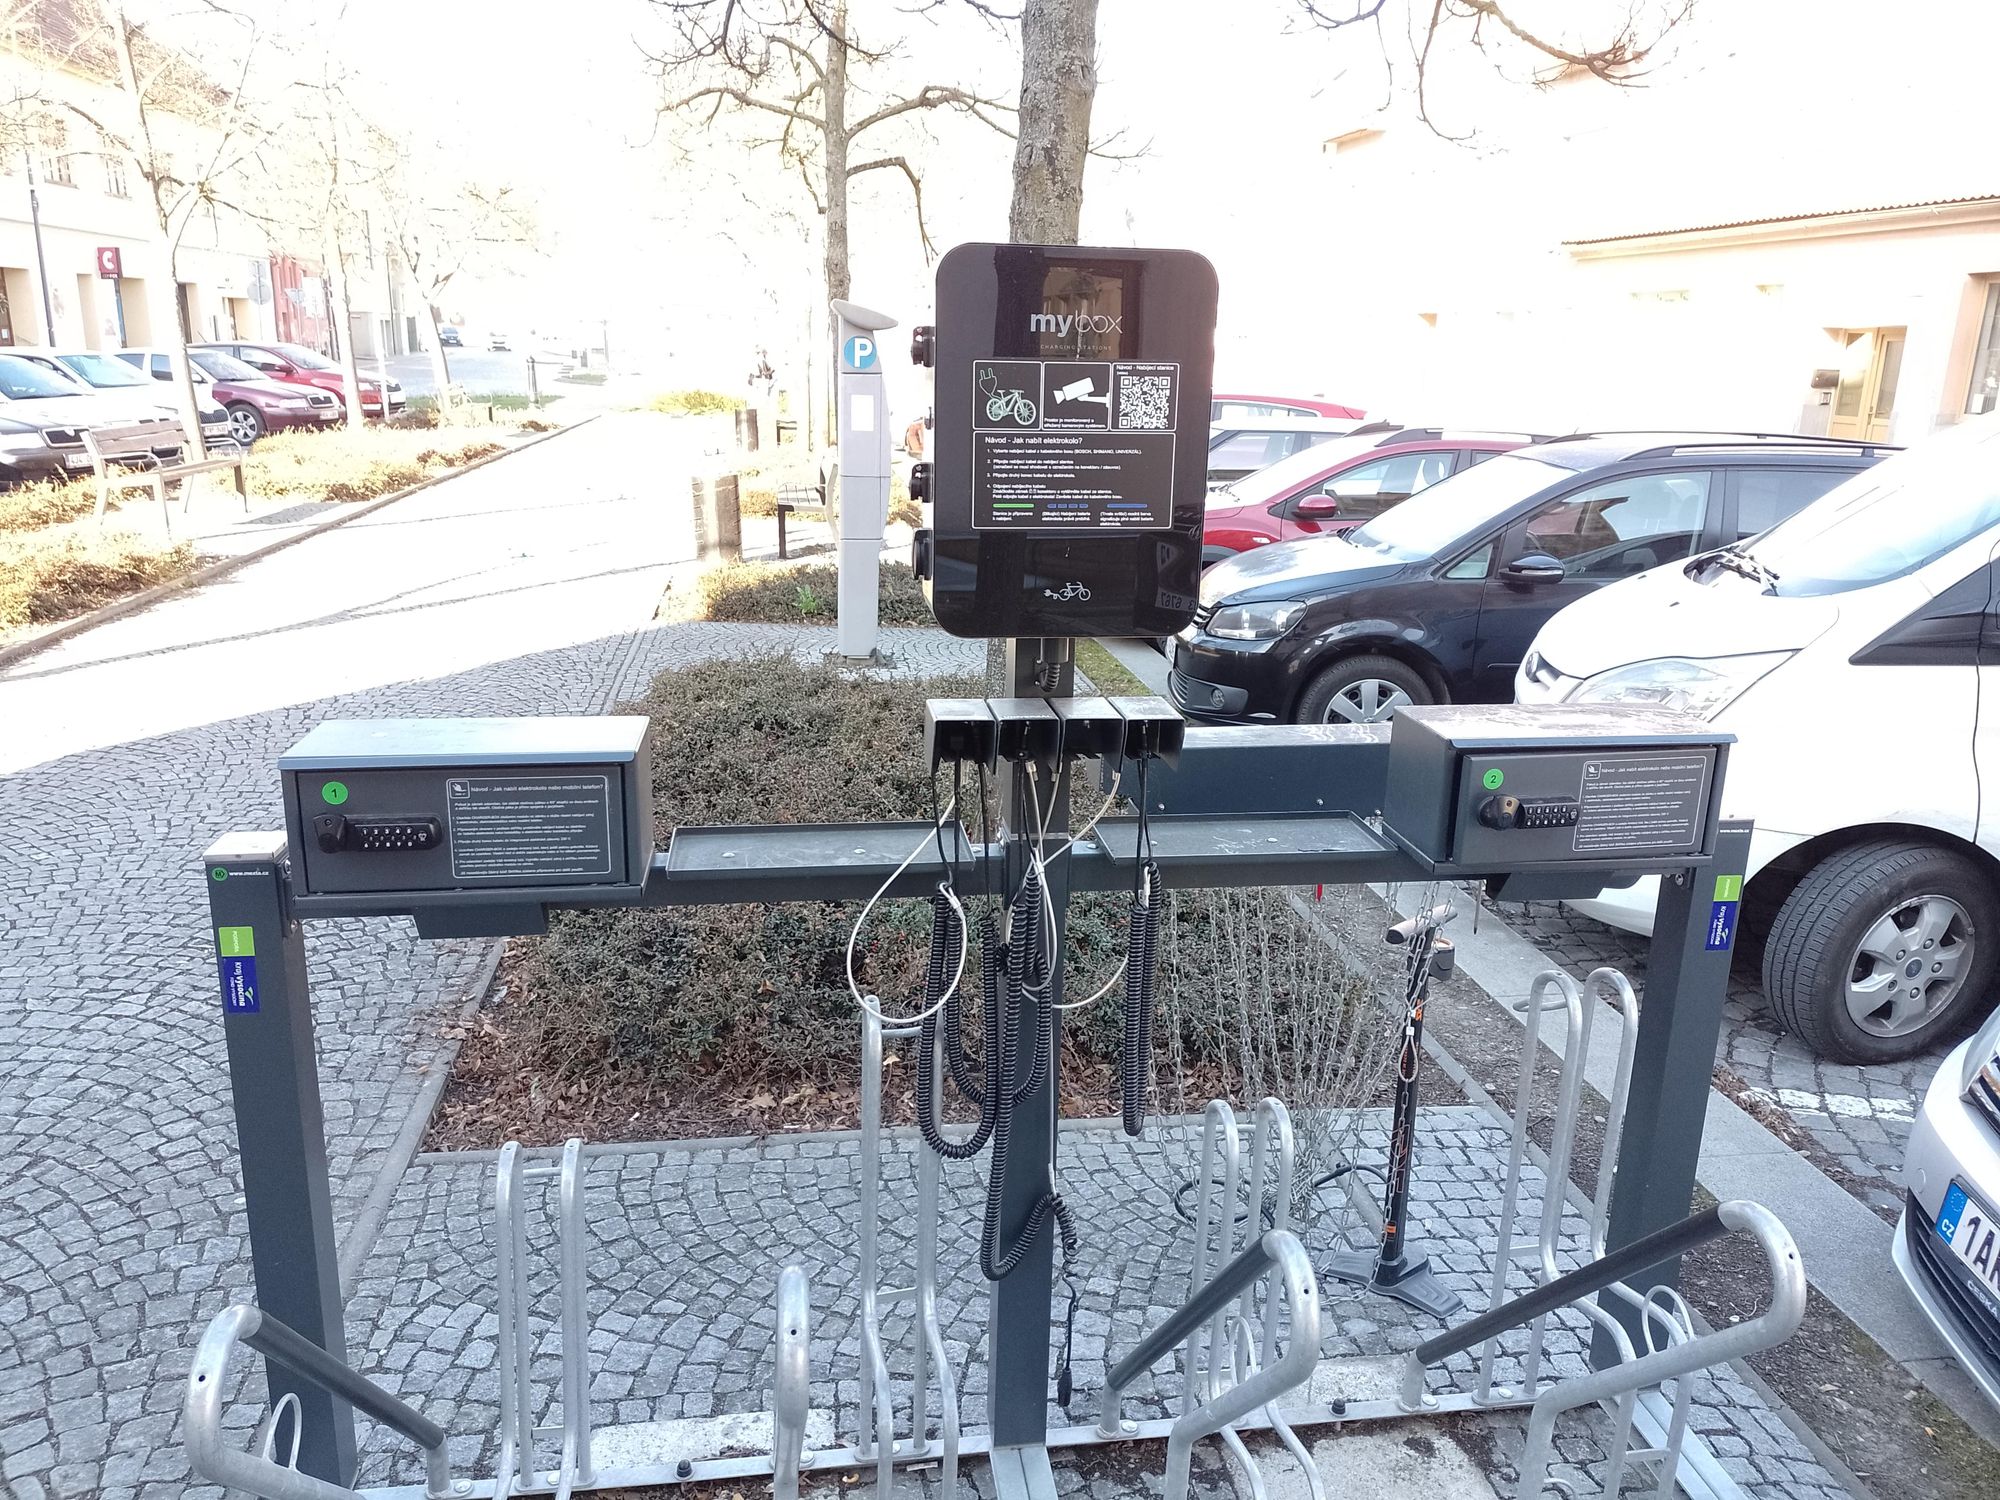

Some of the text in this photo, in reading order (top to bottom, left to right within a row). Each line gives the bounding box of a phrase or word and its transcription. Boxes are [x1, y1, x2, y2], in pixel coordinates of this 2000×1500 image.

[854, 337, 873, 368] P
[985, 436, 1006, 444] Návod
[1490, 775, 1497, 784] 2
[331, 788, 337, 798] 1
[233, 961, 242, 976] Kraj
[1942, 1218, 1955, 1238] CZ
